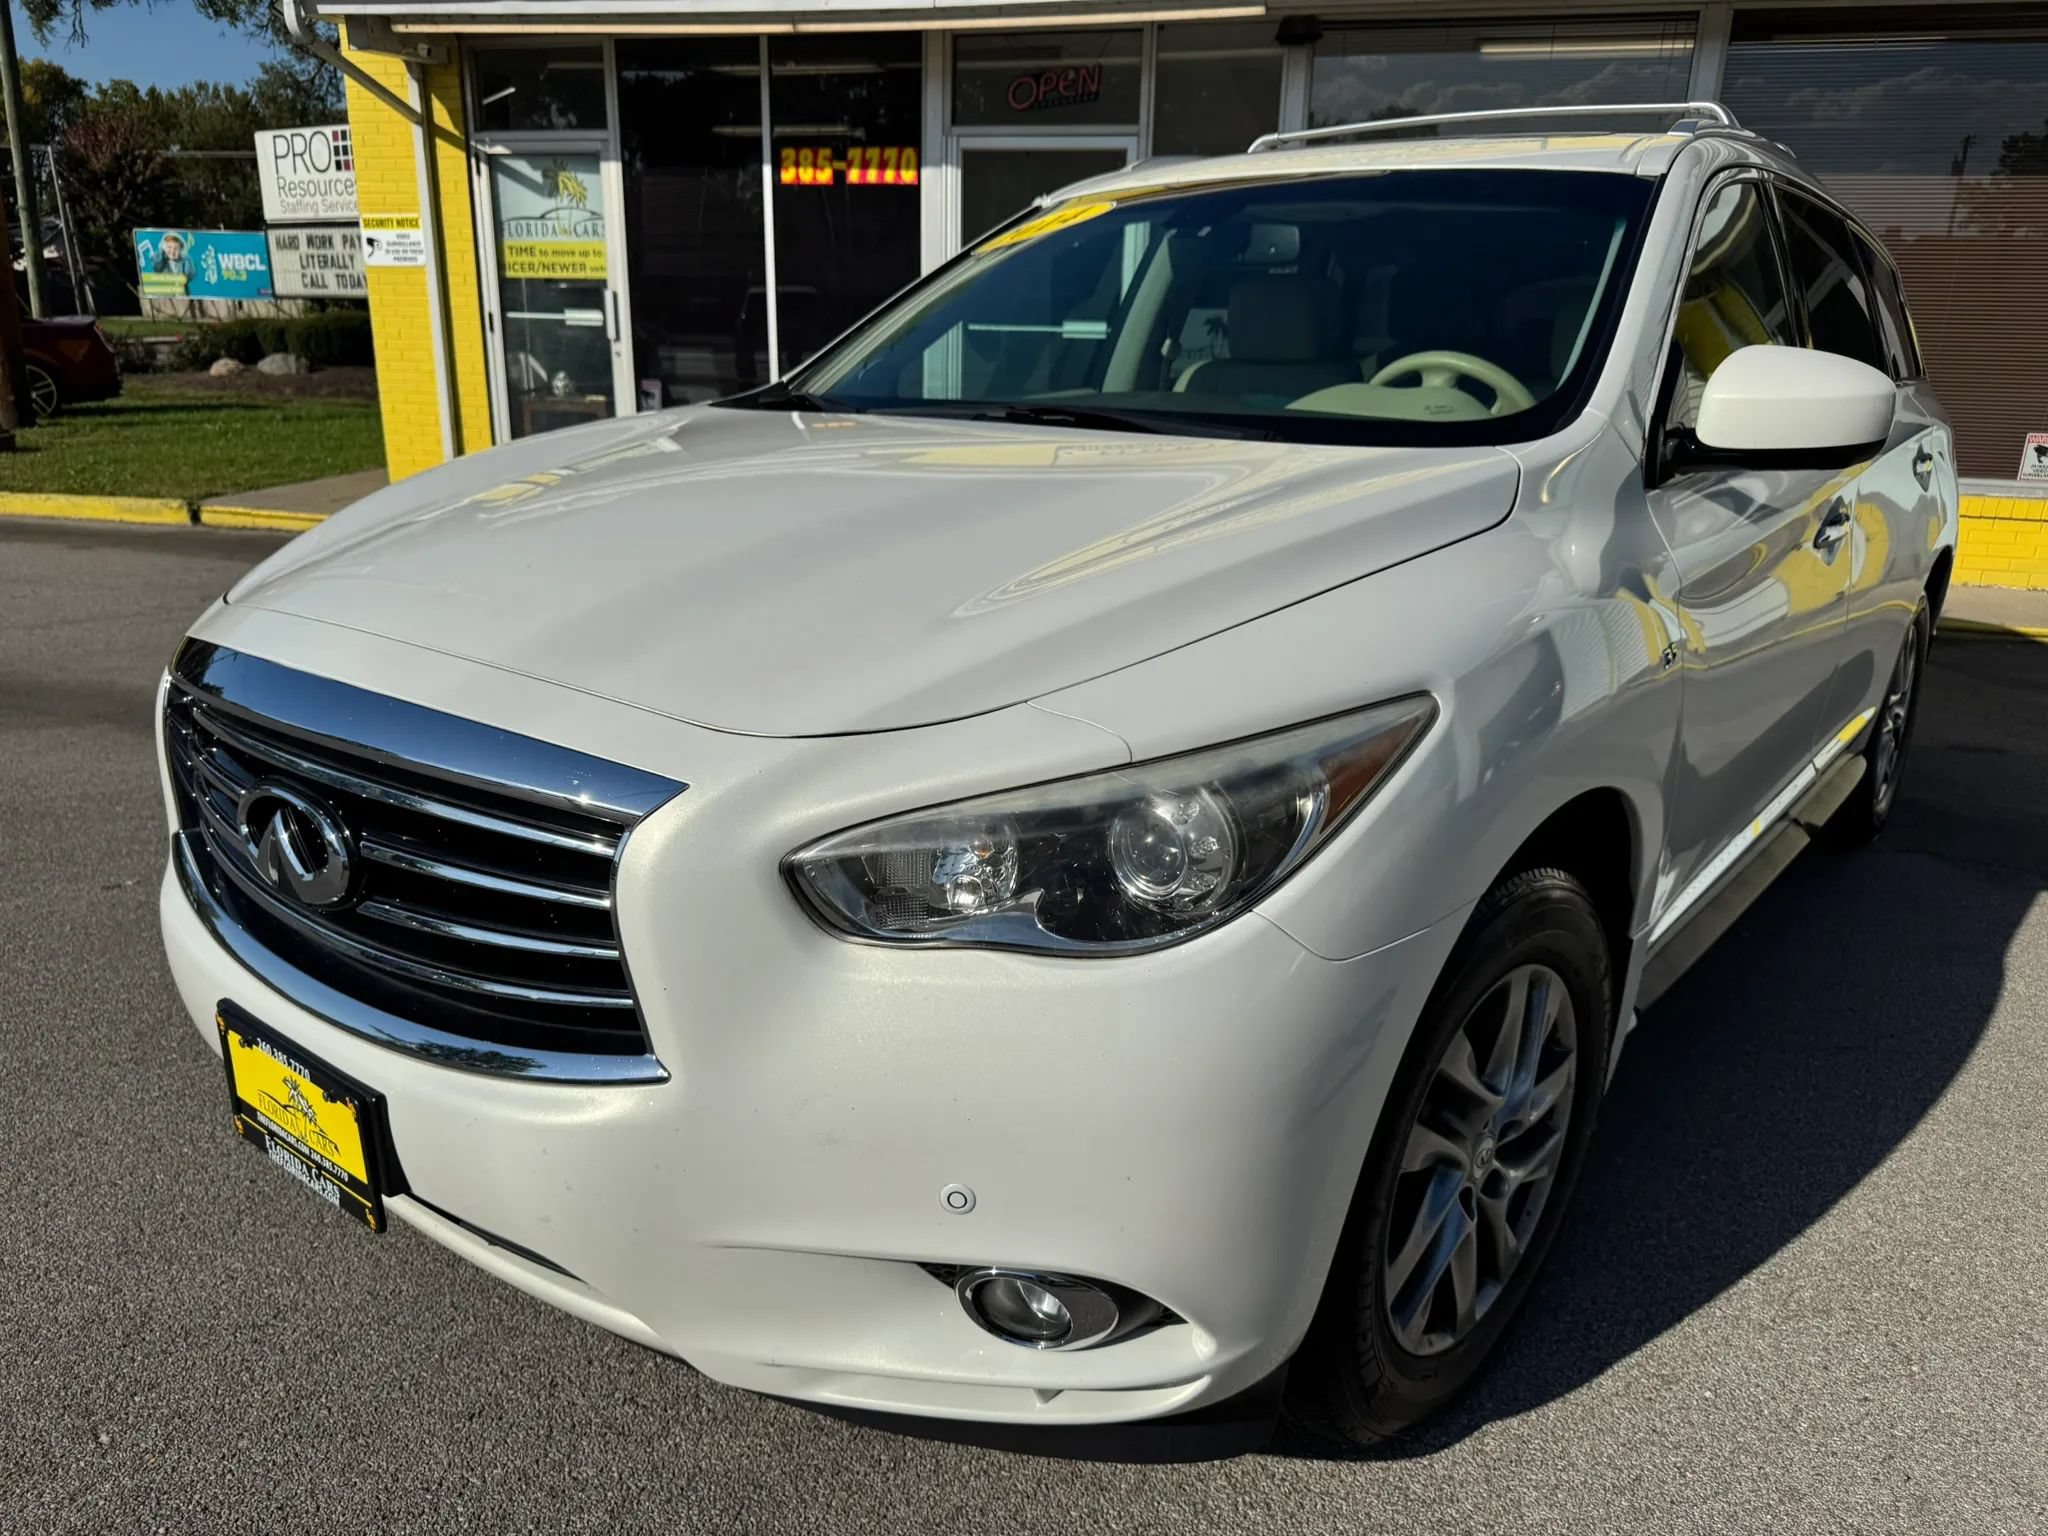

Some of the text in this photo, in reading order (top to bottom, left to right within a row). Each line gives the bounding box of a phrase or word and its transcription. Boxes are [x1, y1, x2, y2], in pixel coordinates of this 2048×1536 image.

[1008, 63, 1102, 110] OPEN
[273, 131, 331, 174] PRO
[781, 147, 918, 184] 385-7770
[280, 198, 319, 216] Staffing
[396, 217, 420, 229] NOTICE
[275, 234, 299, 250] HARD
[306, 233, 334, 250] WORK
[508, 245, 537, 258] TIME
[552, 249, 576, 257] move
[579, 249, 591, 259] up
[218, 253, 267, 271] WBCL
[300, 254, 354, 270] LITERALLY
[301, 273, 328, 289] CALL
[257, 1037, 310, 1082] 260.385.7770
[258, 1092, 335, 1157] FLORIDA CARS
[265, 1134, 340, 1198] FLORIDA CARS
